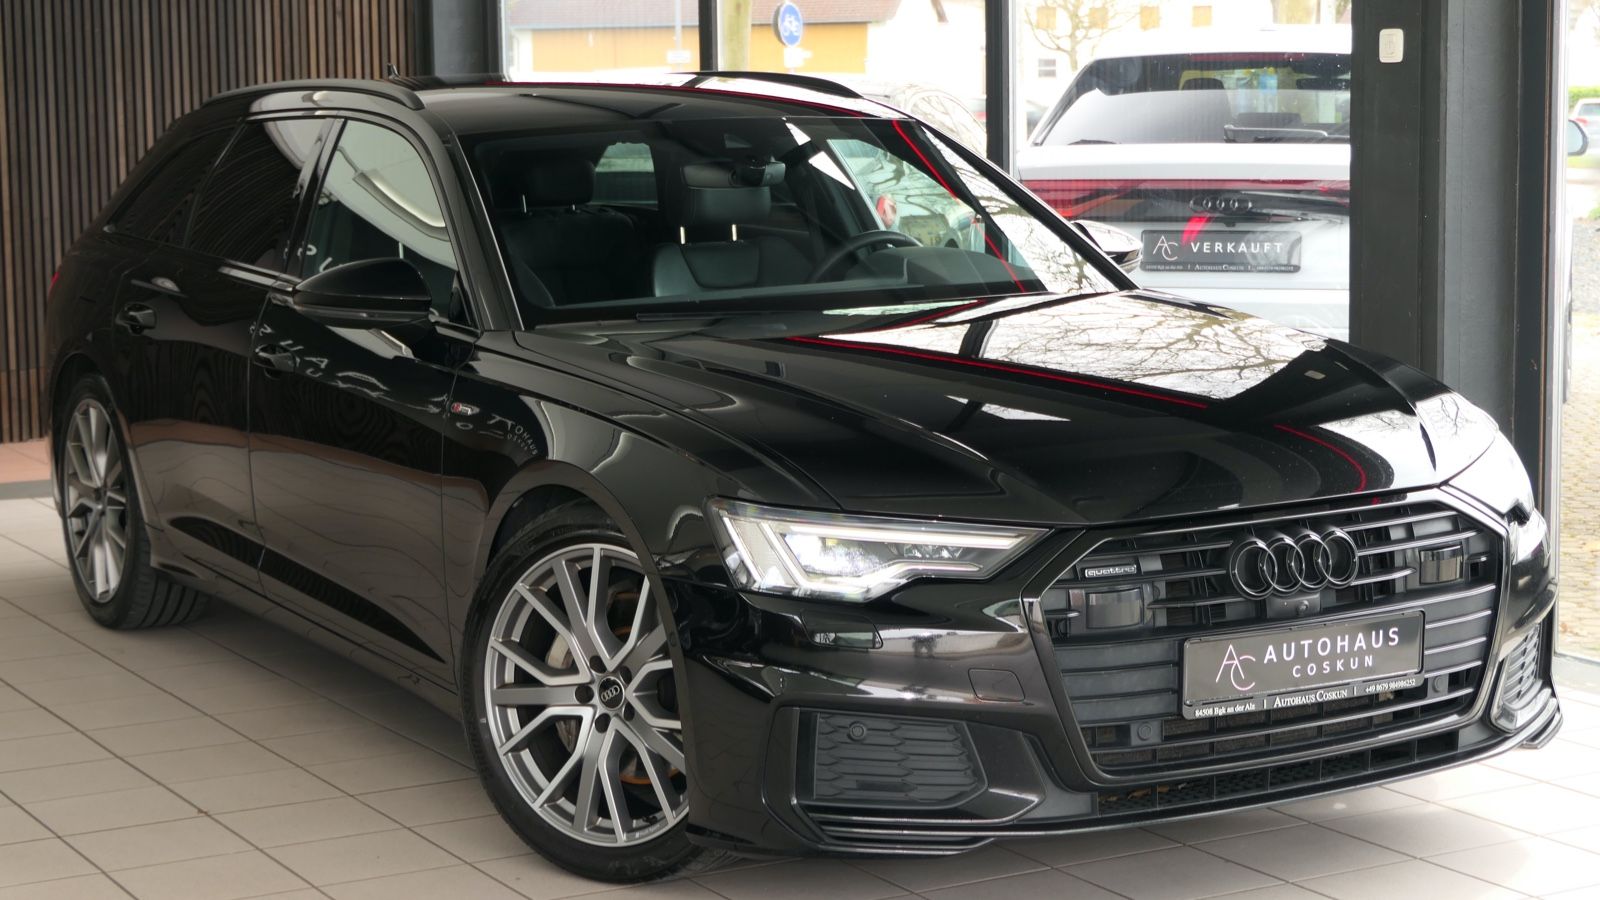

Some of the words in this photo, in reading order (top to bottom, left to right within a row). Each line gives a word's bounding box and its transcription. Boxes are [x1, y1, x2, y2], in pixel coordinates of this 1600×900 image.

[1190, 241, 1283, 253] VERKAUFT
[1087, 566, 1136, 577] quattro
[1263, 627, 1399, 664] AUTOHAUS
[1292, 654, 1373, 678] COSKUN
[1365, 685, 1375, 694] +49
[1235, 703, 1245, 712] der
